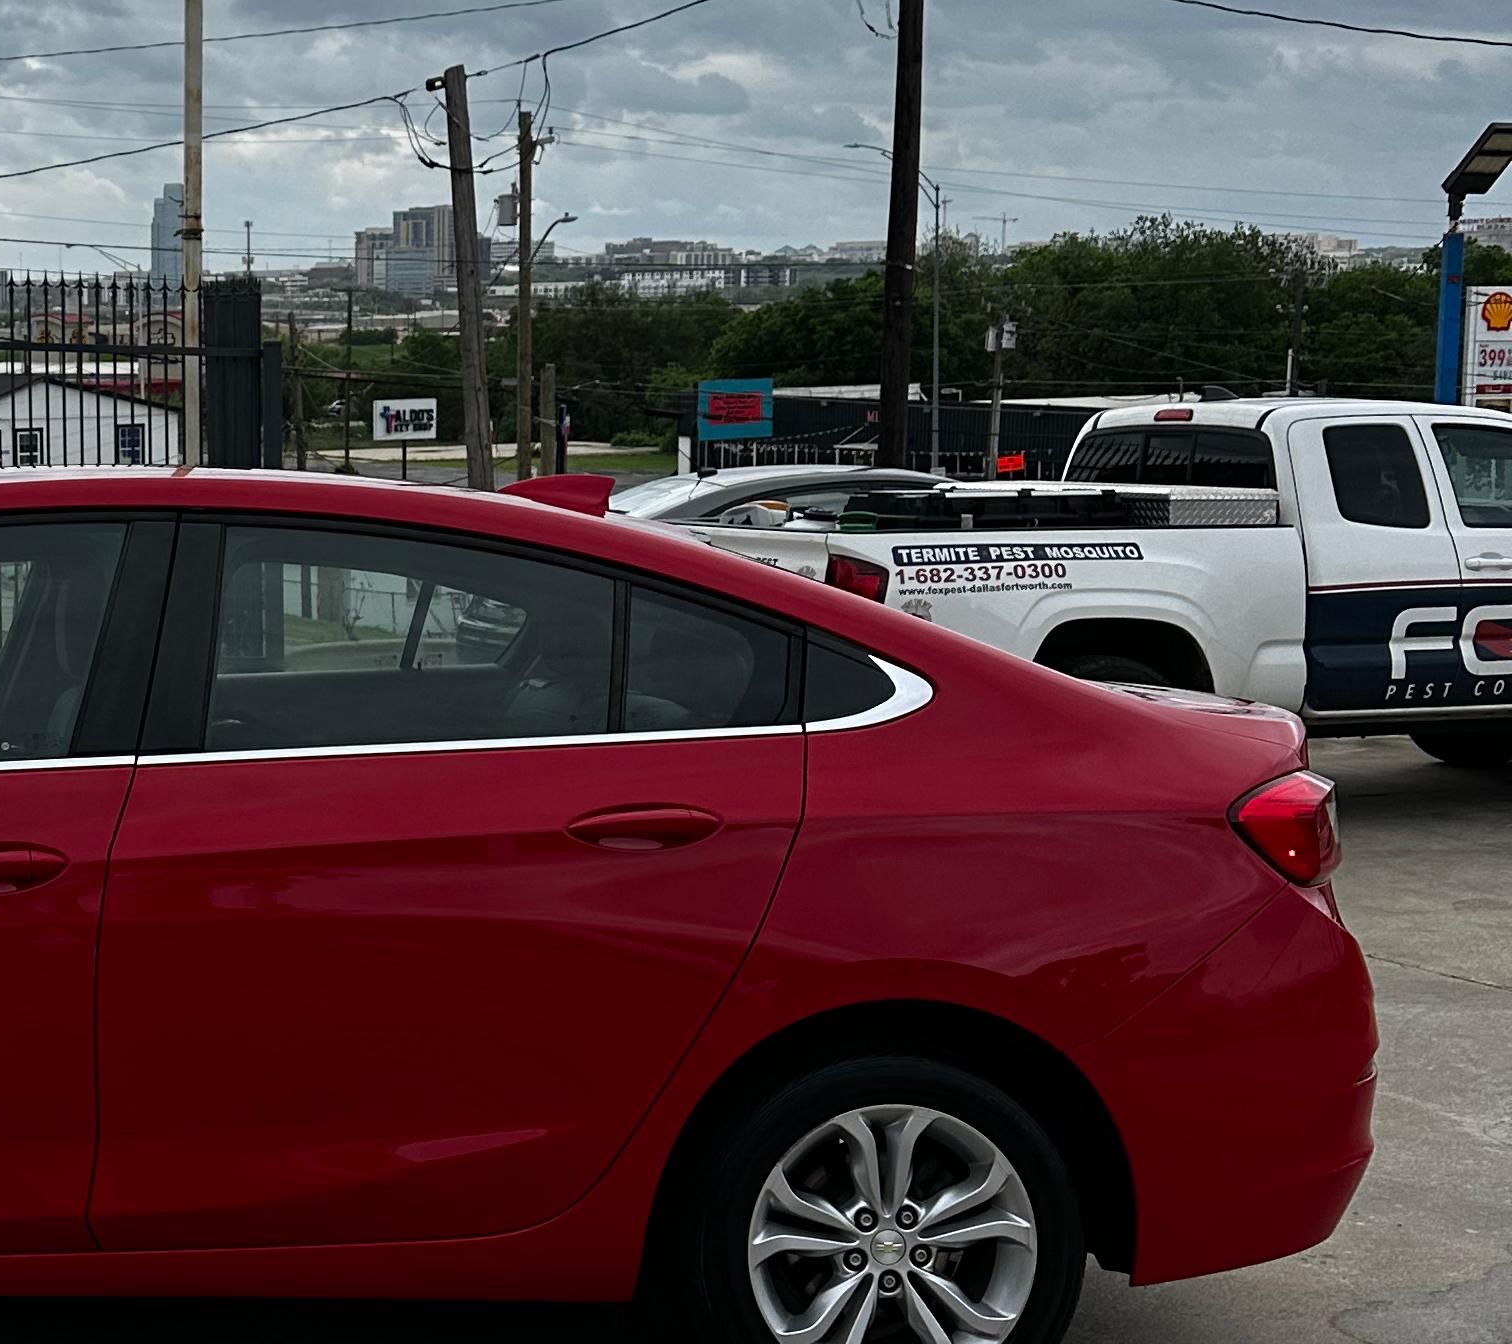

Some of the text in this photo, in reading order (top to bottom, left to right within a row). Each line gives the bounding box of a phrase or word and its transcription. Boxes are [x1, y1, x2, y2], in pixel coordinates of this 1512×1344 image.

[1479, 348, 1506, 367] 399
[394, 409, 434, 423] ALDO'S
[897, 545, 1139, 563] TERMITE PEST MOSQUITO
[895, 562, 1067, 585] 1-682-337-0300
[898, 581, 1073, 596] www.foxpest-dallasfortworth.com
[1384, 679, 1506, 700] PEST CO
